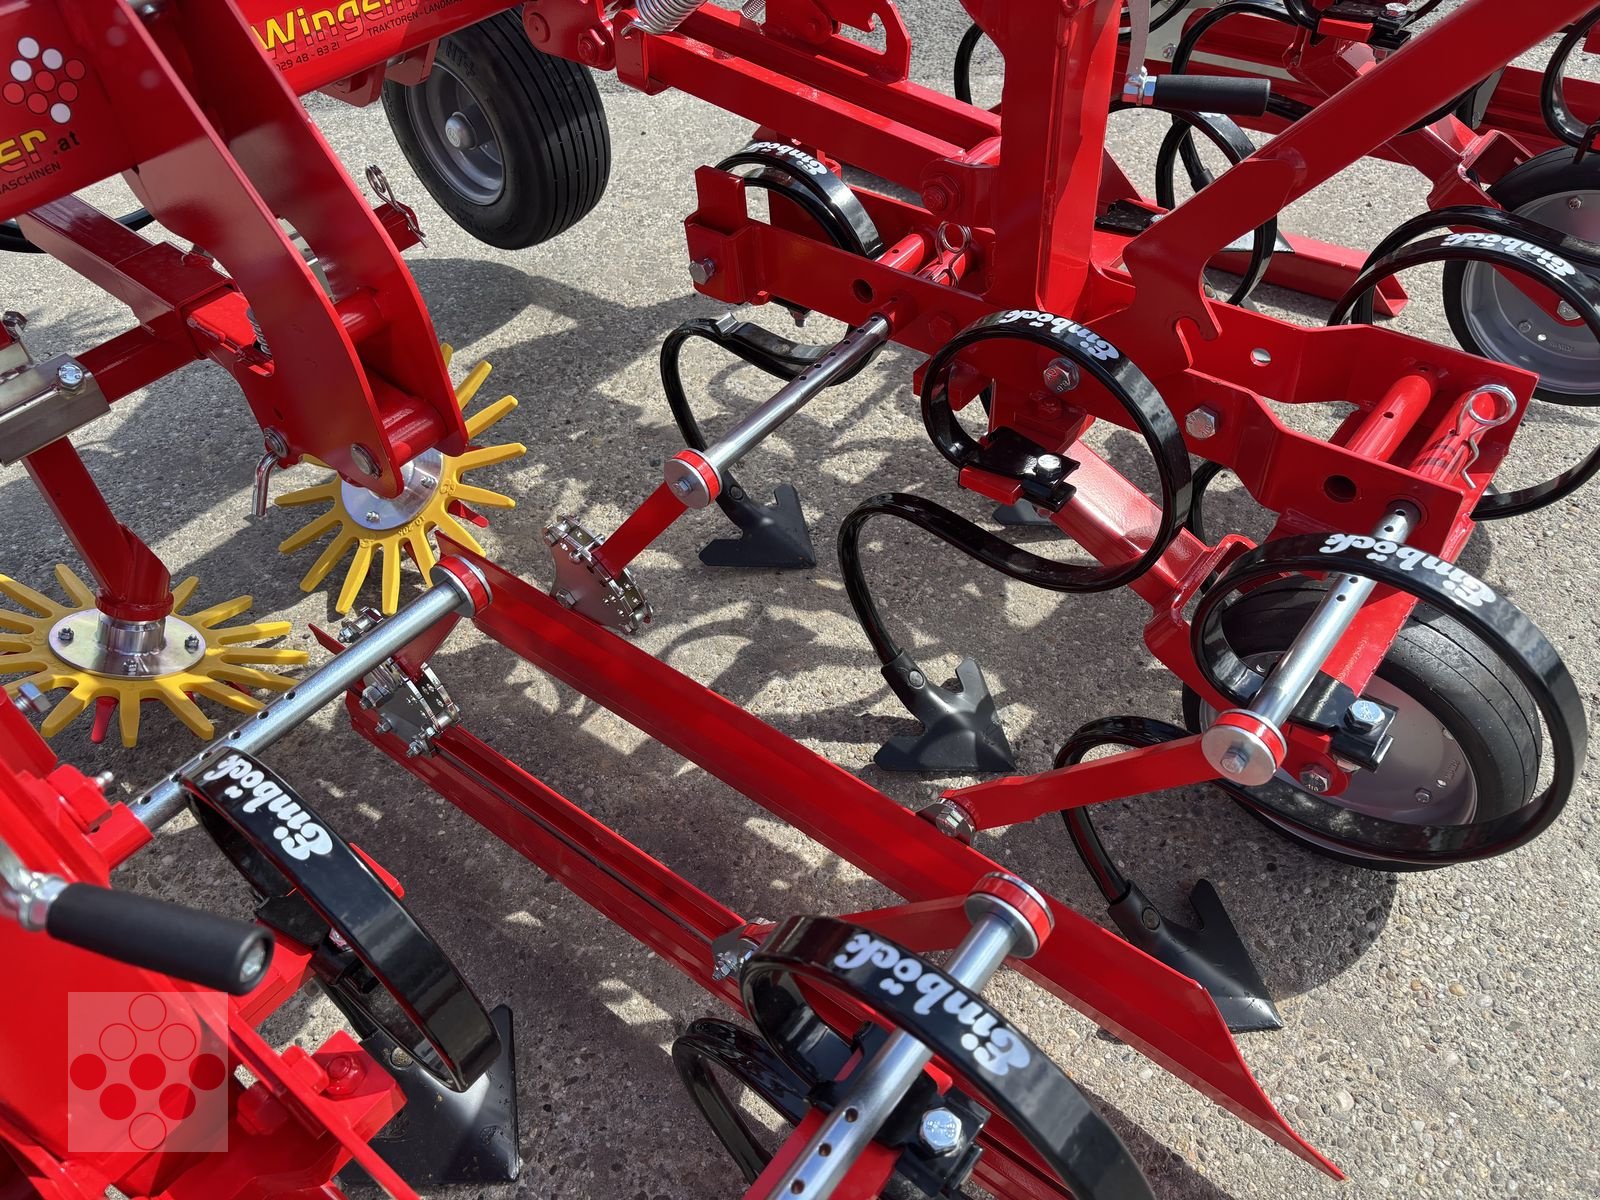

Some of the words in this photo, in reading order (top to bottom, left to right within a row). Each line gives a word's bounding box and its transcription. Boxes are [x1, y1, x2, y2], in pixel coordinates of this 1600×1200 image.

[367, 11, 419, 38] TRAKTOREN
[296, 53, 309, 65] 48
[317, 46, 328, 58] 83
[329, 42, 340, 54] 21
[0, 161, 62, 196] ASCHINEN
[1440, 232, 1576, 277] Einböck
[998, 309, 1120, 361] Einböck
[1318, 533, 1497, 607] Einböck
[203, 754, 334, 861] Einböck
[834, 933, 1031, 1077] Einböck
